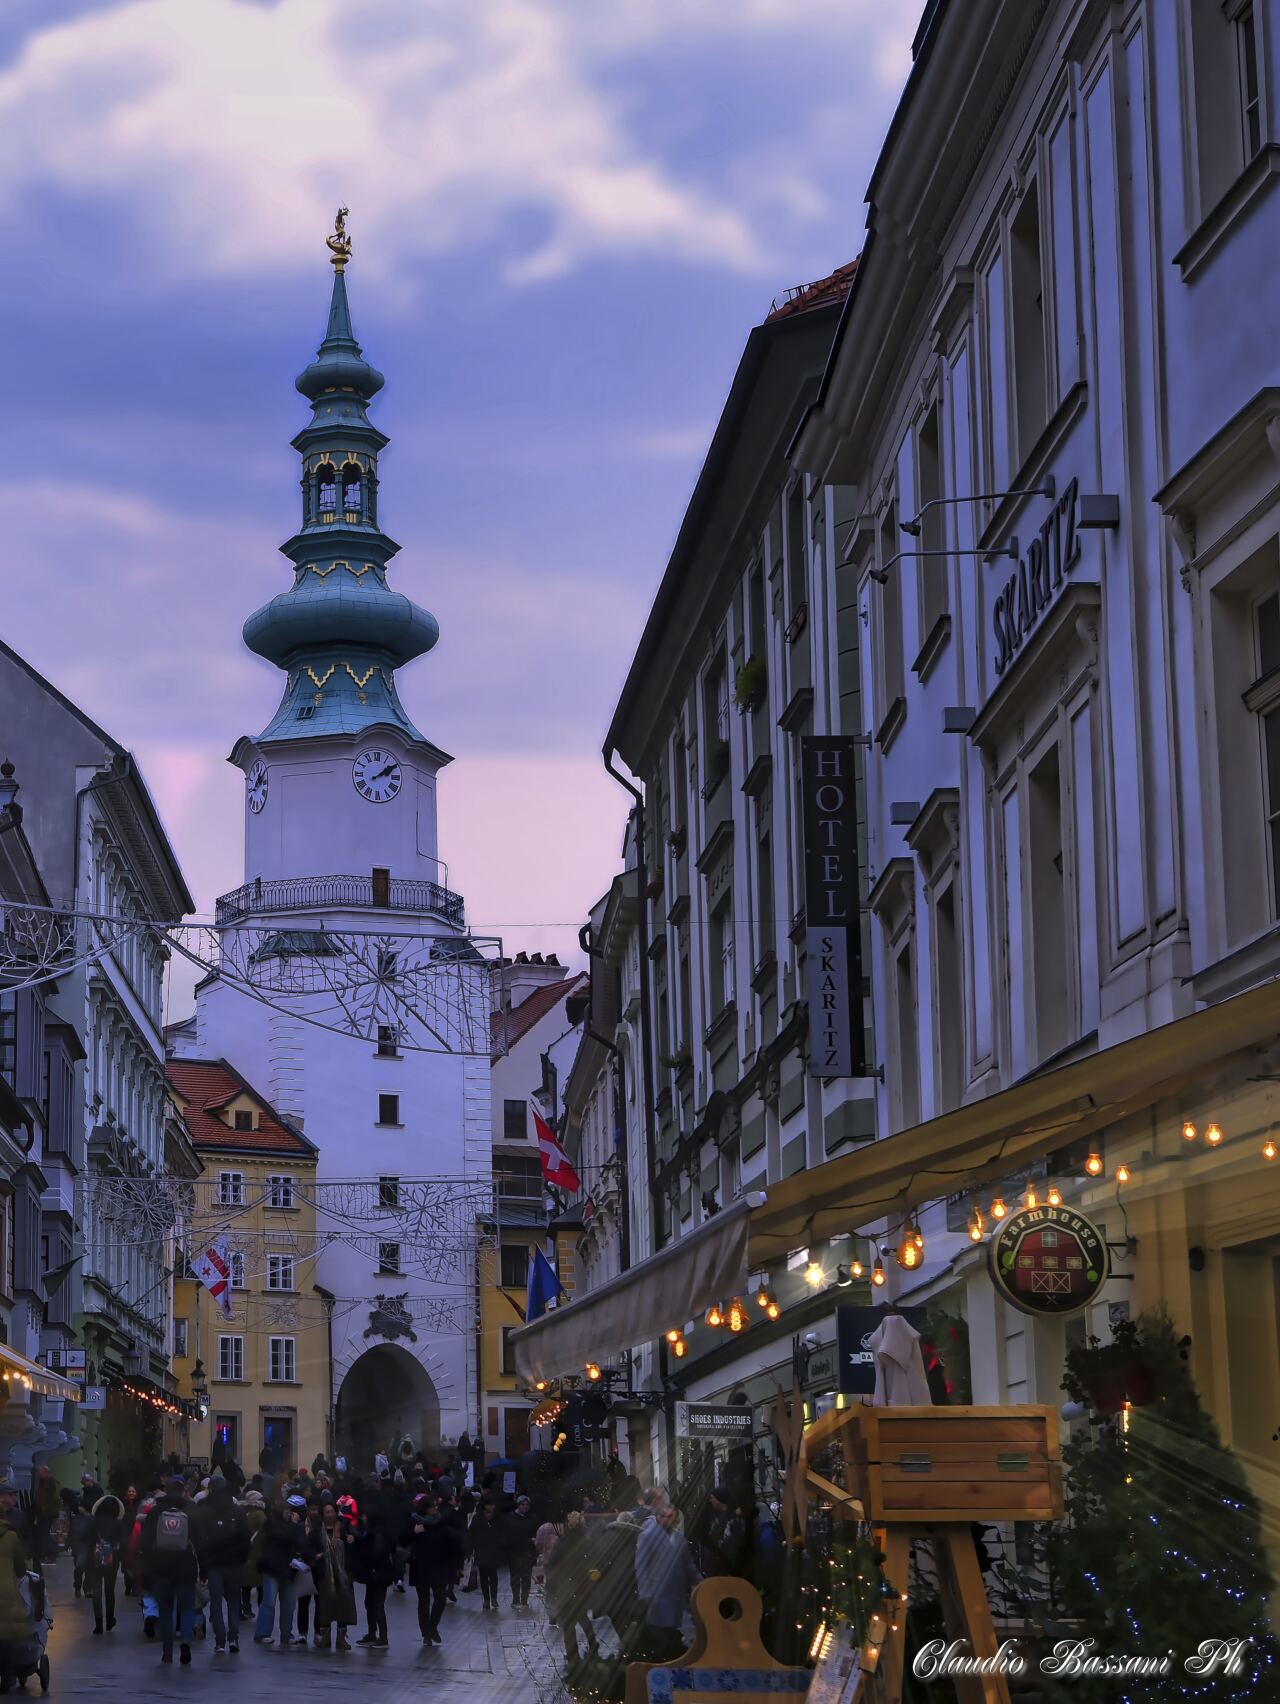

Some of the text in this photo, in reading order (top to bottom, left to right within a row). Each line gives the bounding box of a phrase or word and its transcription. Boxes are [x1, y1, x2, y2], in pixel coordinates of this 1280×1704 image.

[994, 476, 1081, 675] SKARITZ
[814, 750, 846, 917] HOTEL
[820, 936, 839, 1067] SKARITZ
[1000, 1208, 1097, 1248] Farmhouse
[690, 1414, 751, 1425] SHOES INDUSTRIES
